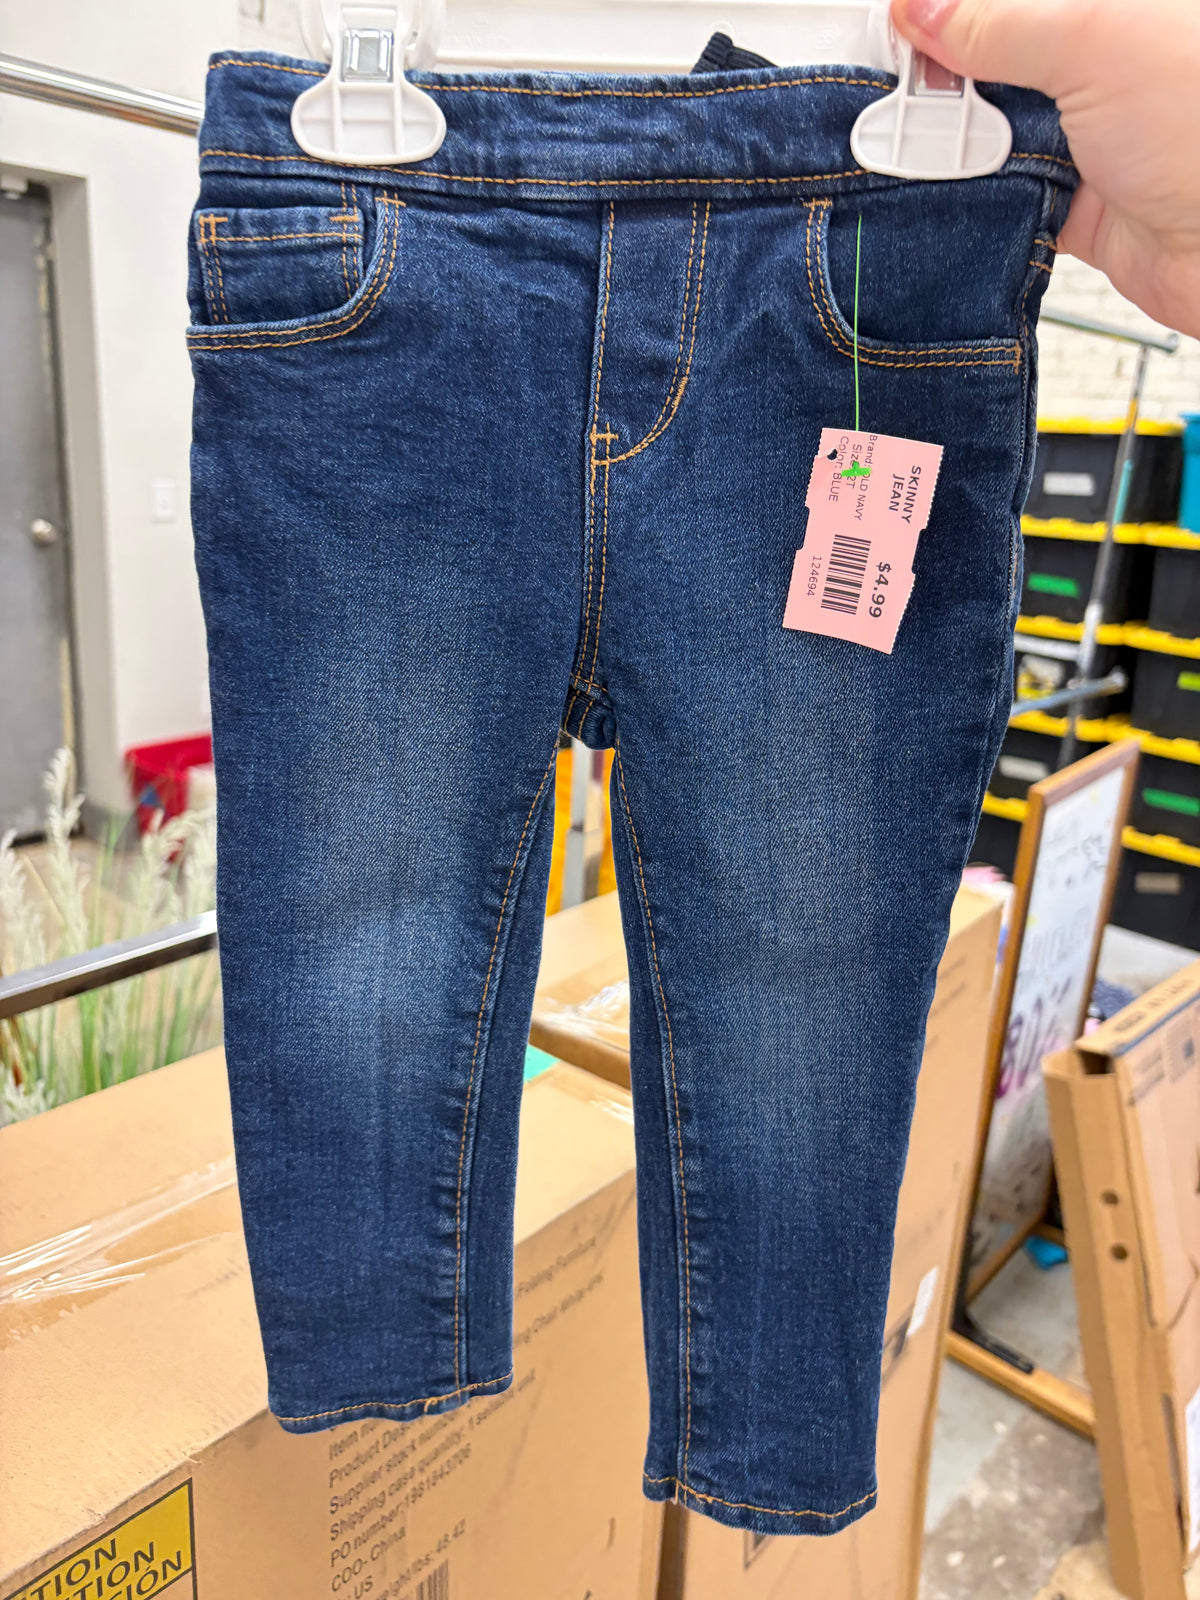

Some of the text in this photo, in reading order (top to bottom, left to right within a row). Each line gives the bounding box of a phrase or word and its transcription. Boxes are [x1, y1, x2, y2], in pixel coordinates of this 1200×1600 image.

[828, 436, 849, 502] Color: BLUE
[864, 434, 878, 467] Brand:
[854, 494, 867, 520] NAVY
[889, 474, 905, 512] JEAN
[901, 465, 922, 524] SKINNY
[806, 555, 822, 597] 124694
[869, 562, 892, 619] $4.99
[329, 1439, 380, 1488] Product
[330, 1465, 382, 1515] Supplier
[330, 1490, 386, 1541] Shipping
[23, 1537, 117, 1600] TION
[66, 1541, 155, 1600] TION
[110, 1550, 182, 1600] IÓN
[330, 1541, 351, 1568] PO
[354, 1575, 374, 1600] US
